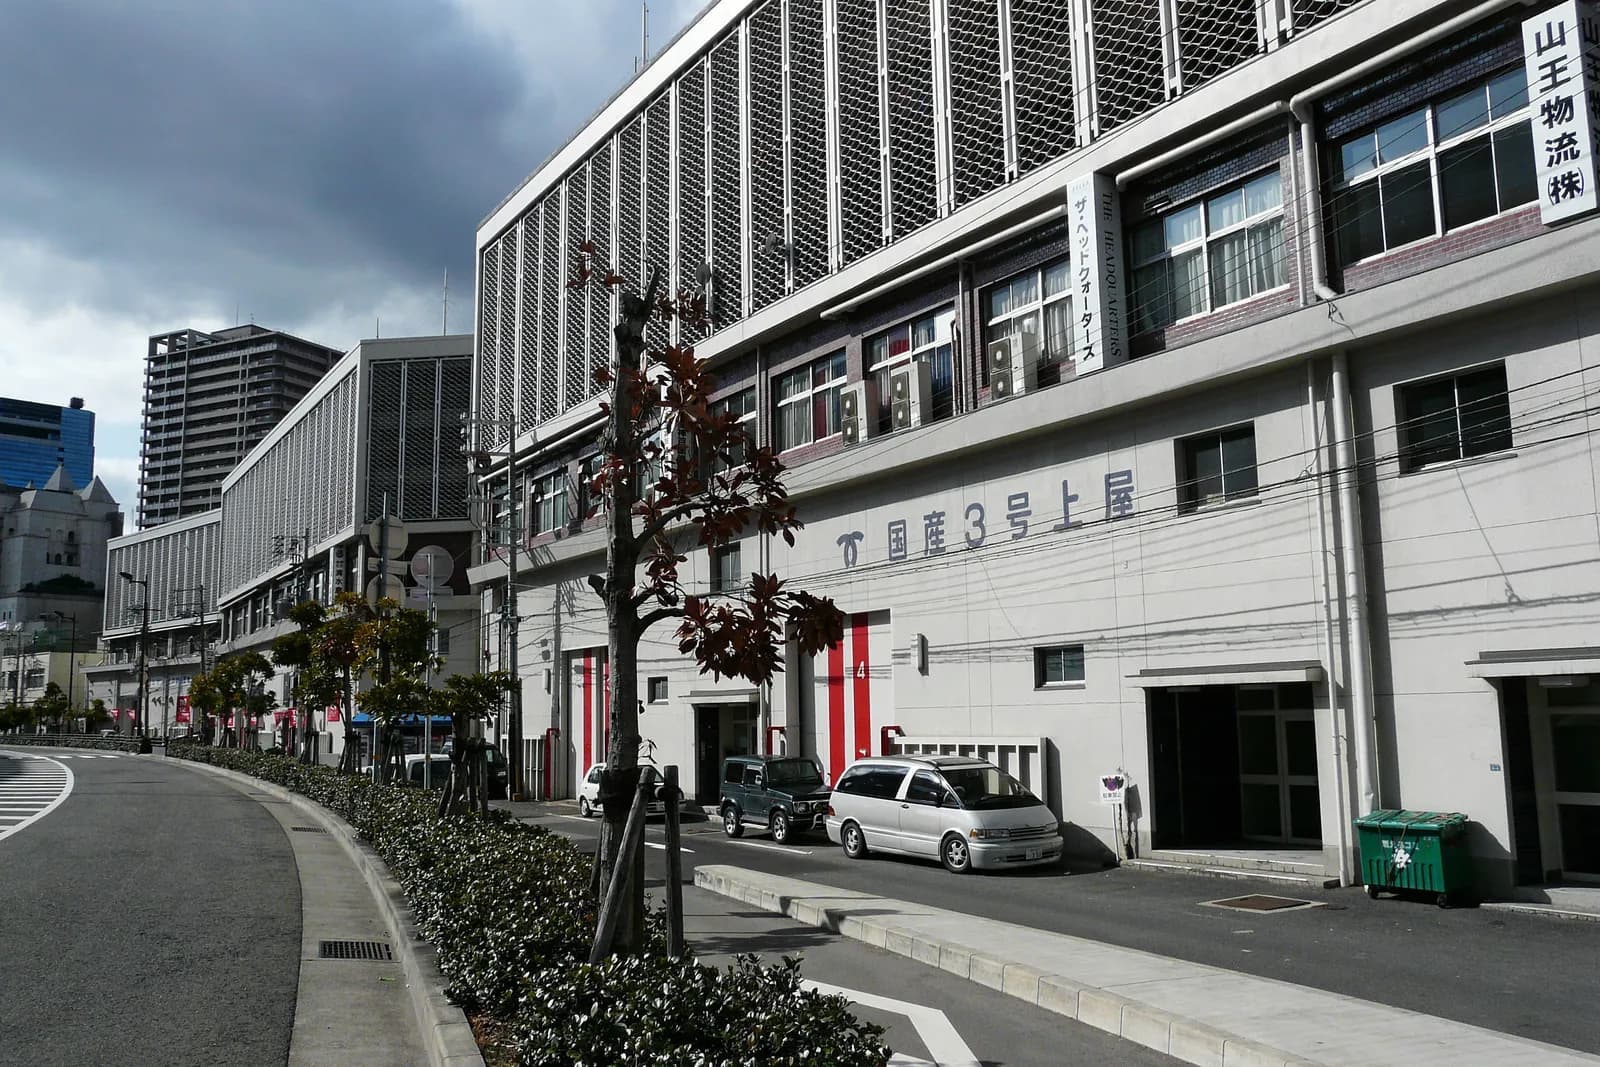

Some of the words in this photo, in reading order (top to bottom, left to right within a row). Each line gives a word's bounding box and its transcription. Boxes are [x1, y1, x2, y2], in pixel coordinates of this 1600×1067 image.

[1534, 20, 1584, 206] 山王物流(株)
[1102, 192, 1113, 222] THE
[1104, 231, 1122, 357] HEADQUARTERS
[857, 660, 865, 680] 4
